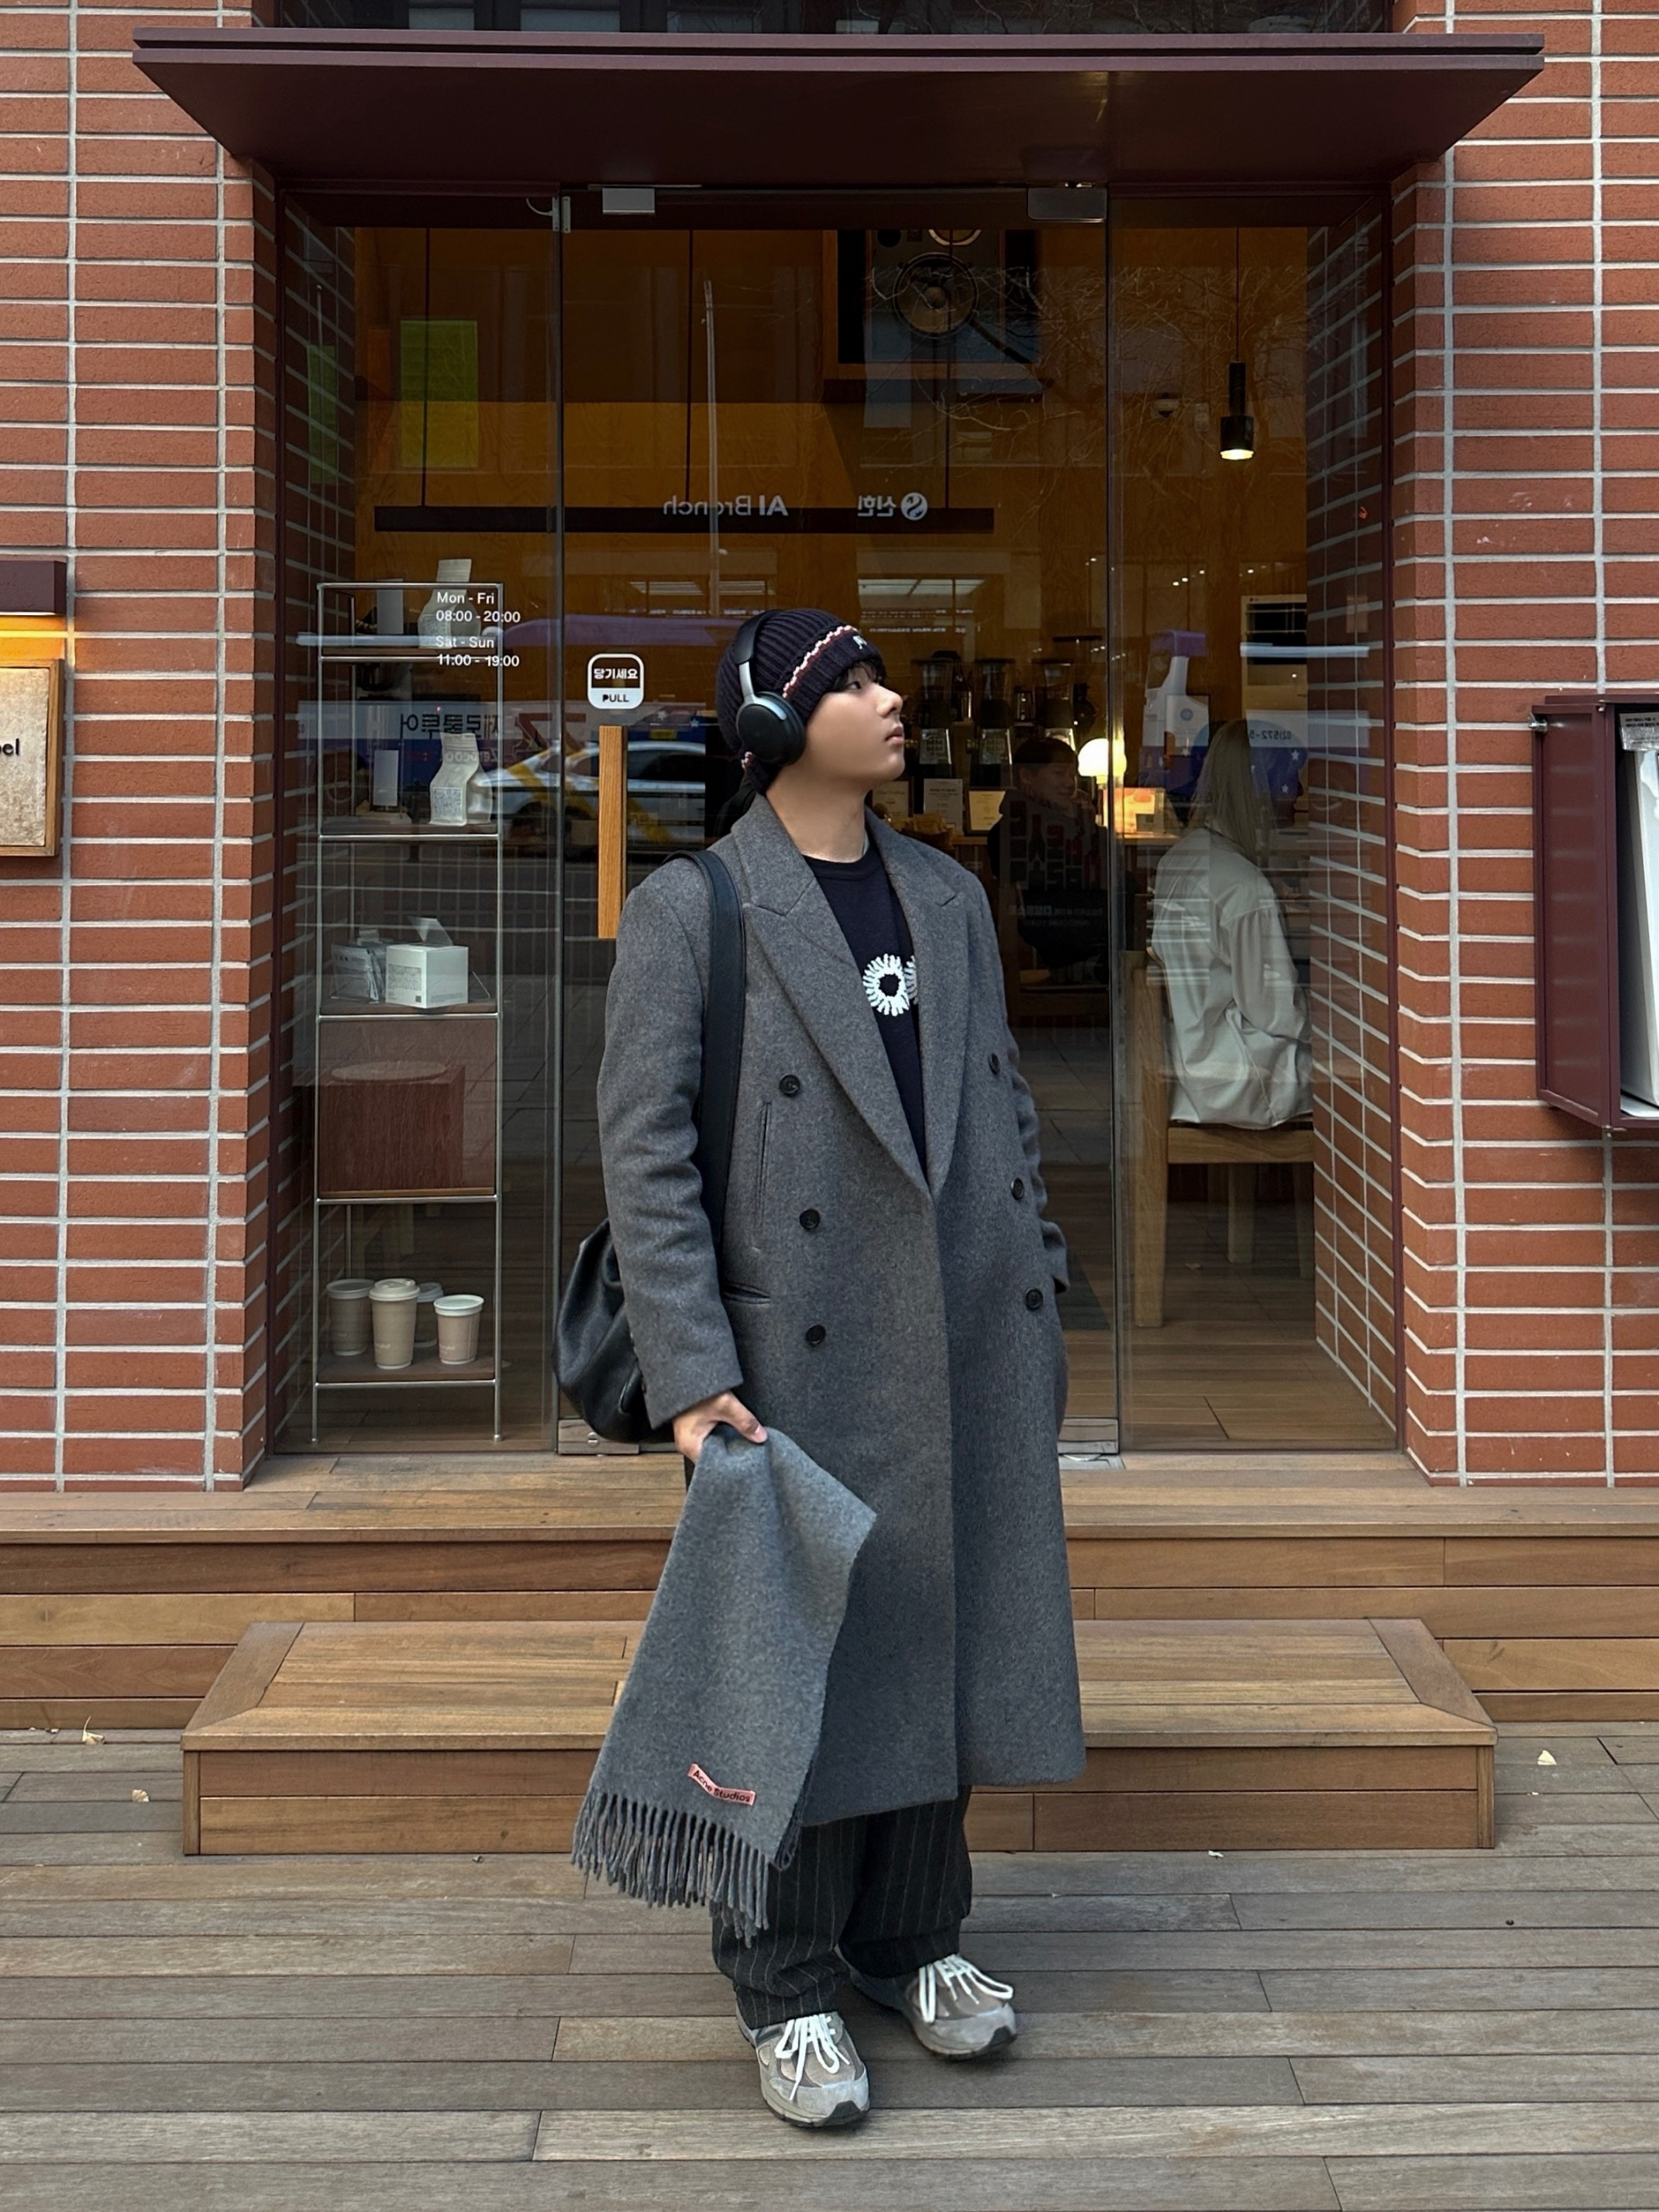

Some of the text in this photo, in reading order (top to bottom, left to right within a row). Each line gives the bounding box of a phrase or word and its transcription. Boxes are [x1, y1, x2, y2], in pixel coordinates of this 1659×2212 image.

[437, 591, 465, 604] Mon
[477, 592, 494, 604] Fri
[436, 610, 473, 621] 08:00
[484, 611, 521, 623] 20:00
[435, 636, 457, 647] Sat
[469, 636, 494, 648] Sun
[437, 654, 471, 666] 11:00
[484, 655, 520, 666] 19:00
[594, 668, 638, 679] 당기세요
[602, 694, 629, 703] PULL
[0, 738, 20, 757] el
[693, 1770, 752, 1803] Acne Studios
